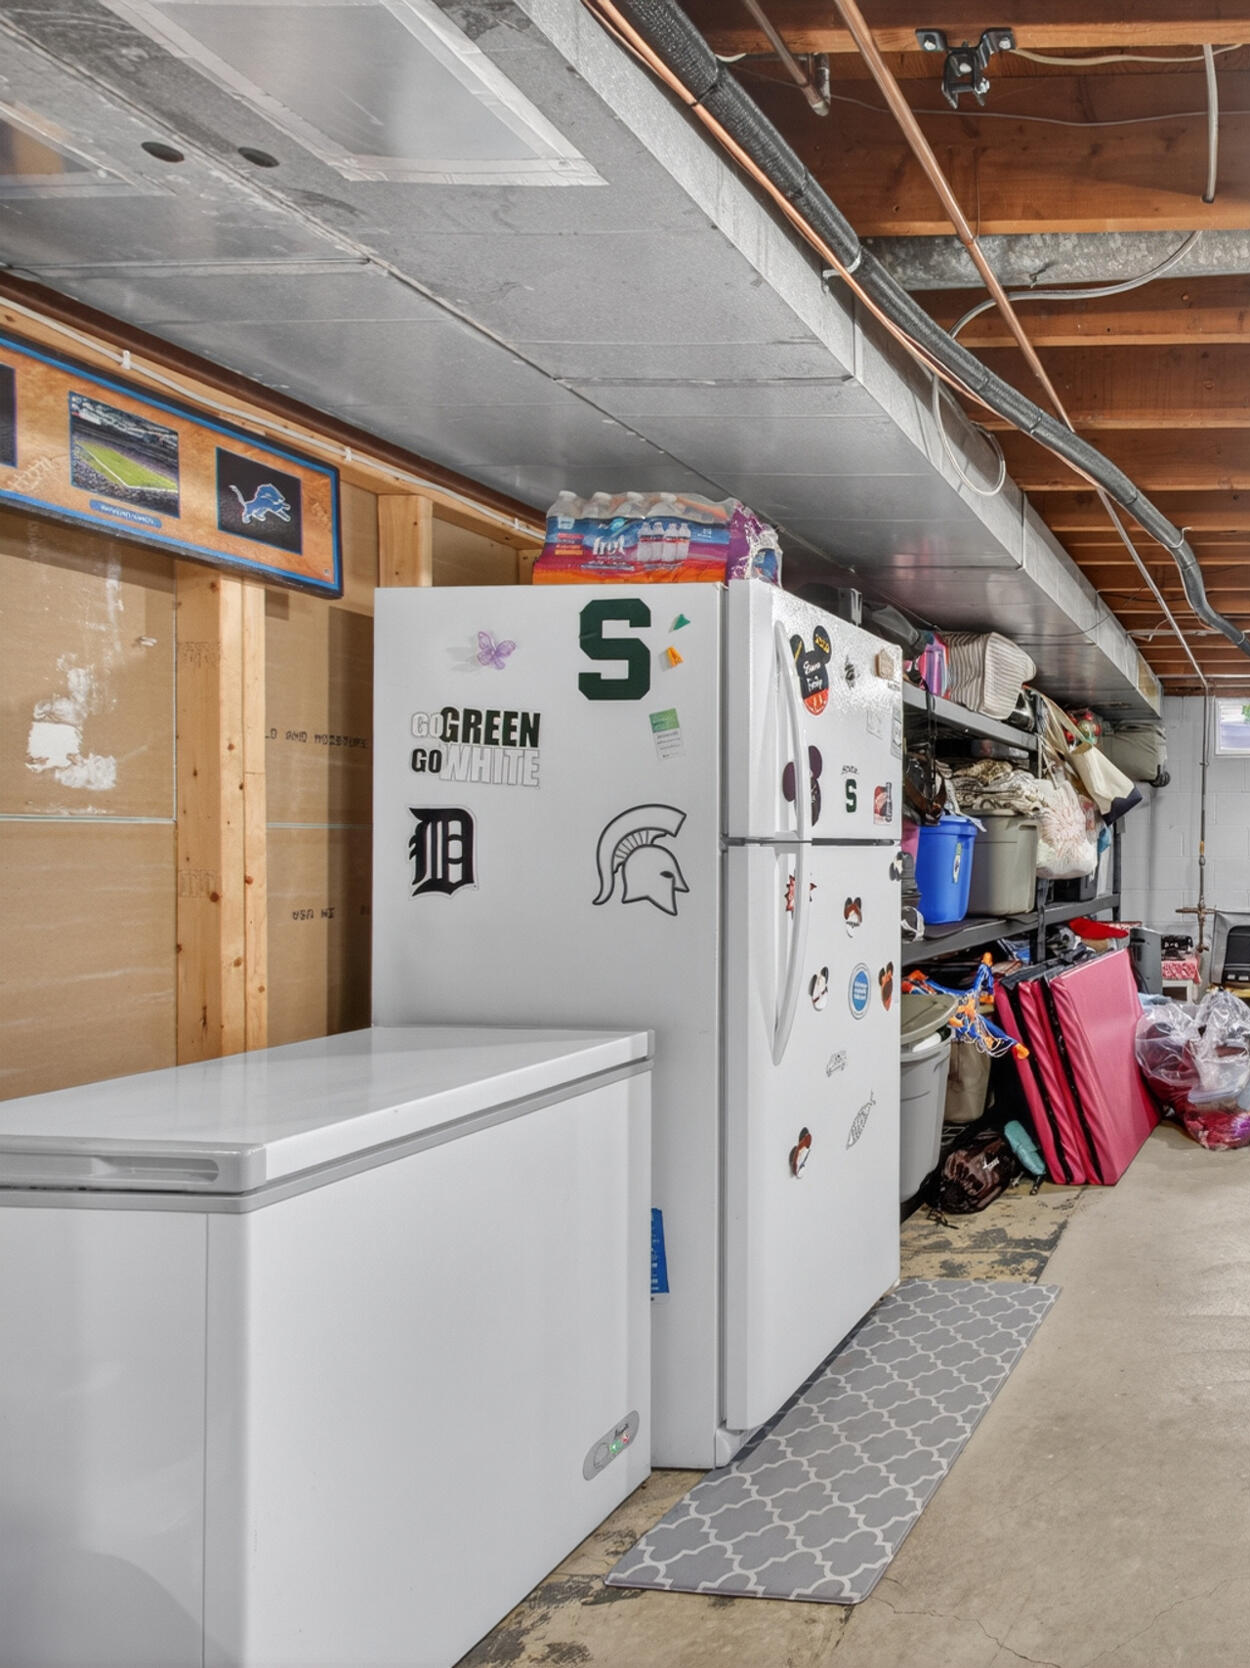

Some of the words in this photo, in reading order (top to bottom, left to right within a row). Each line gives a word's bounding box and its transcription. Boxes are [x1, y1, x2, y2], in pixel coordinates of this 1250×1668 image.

[579, 598, 651, 701] S
[411, 712, 443, 739] GO
[440, 706, 541, 748] GREEN
[411, 748, 442, 773] GO
[439, 745, 540, 787] WHITE
[844, 778, 857, 813] S
[408, 807, 475, 896] D
[292, 908, 314, 920] USA
